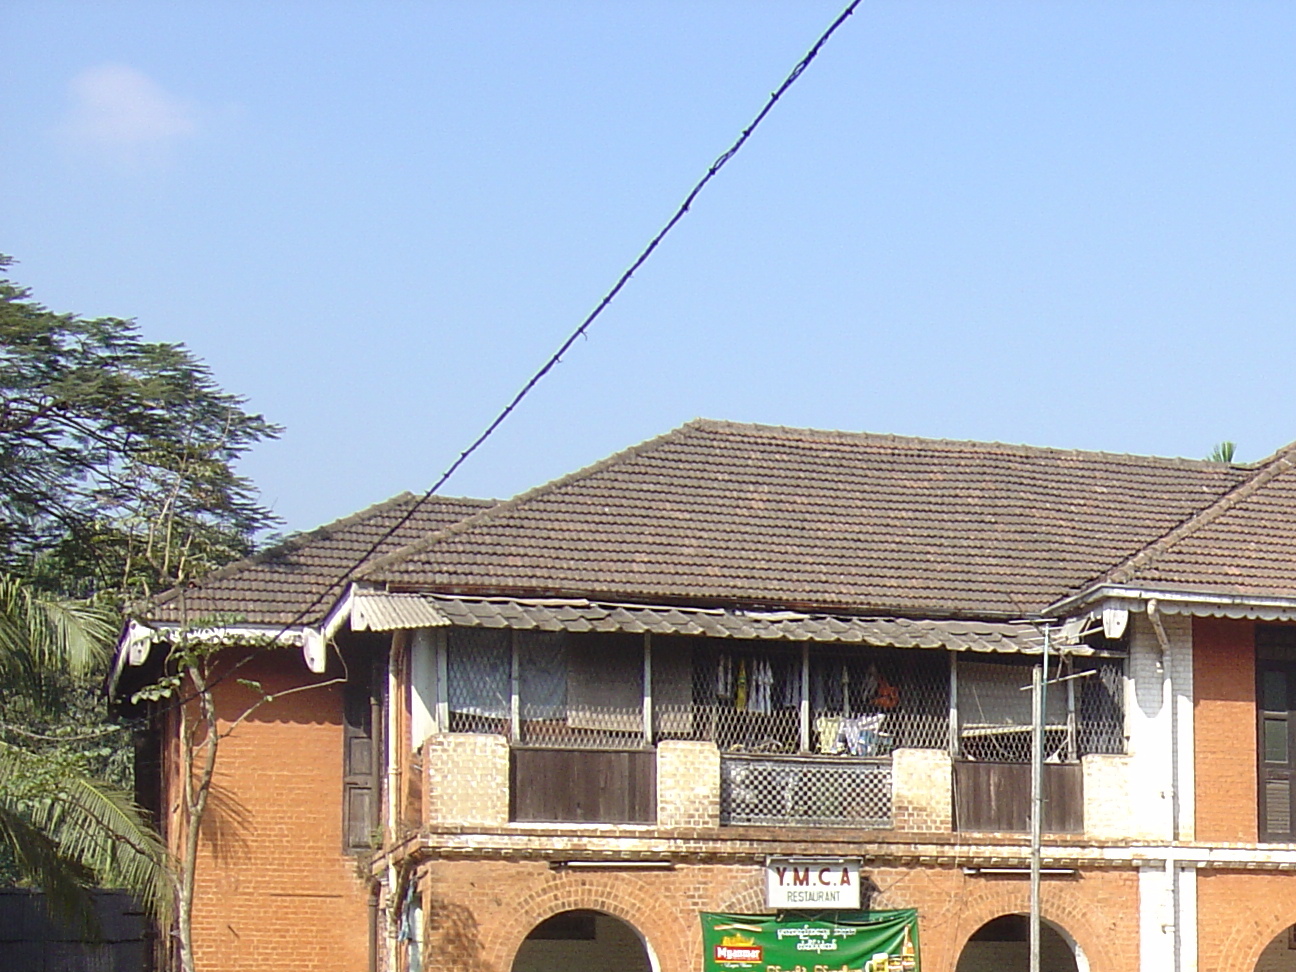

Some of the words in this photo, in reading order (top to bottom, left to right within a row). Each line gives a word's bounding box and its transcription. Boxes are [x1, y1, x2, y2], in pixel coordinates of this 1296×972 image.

[775, 866, 851, 887] Y.M.C.A
[786, 890, 841, 903] RESTAURANT
[716, 946, 761, 960] Myanmar
